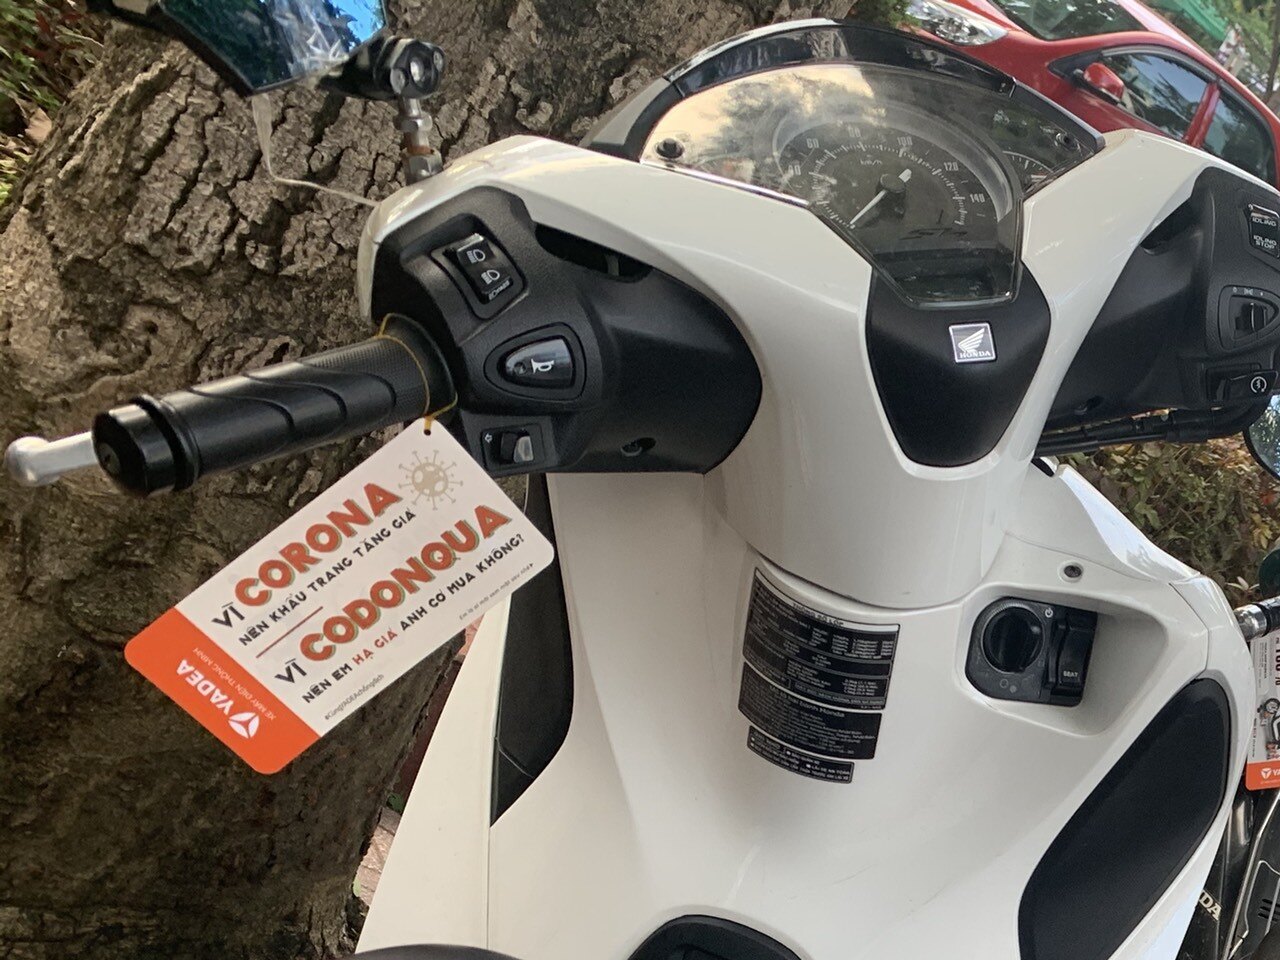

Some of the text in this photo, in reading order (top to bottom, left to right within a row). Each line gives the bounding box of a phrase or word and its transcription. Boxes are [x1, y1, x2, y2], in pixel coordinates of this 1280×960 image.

[1252, 216, 1277, 227] IDLING
[235, 483, 404, 607] CORONA
[239, 620, 270, 646] NÊN
[307, 557, 353, 592] TRANG
[353, 527, 391, 557] TĂNG
[300, 505, 512, 661] CODONQUA
[302, 677, 332, 703] NÊN
[331, 663, 353, 681] EM
[352, 648, 375, 666] HẠ
[400, 606, 428, 631] ANH
[447, 571, 476, 595] MUA
[476, 533, 526, 573] KHÔNG?
[191, 646, 214, 666] MINH
[1062, 670, 1079, 678] SEAT
[173, 657, 237, 714] YADEA
[265, 709, 276, 721] XE
